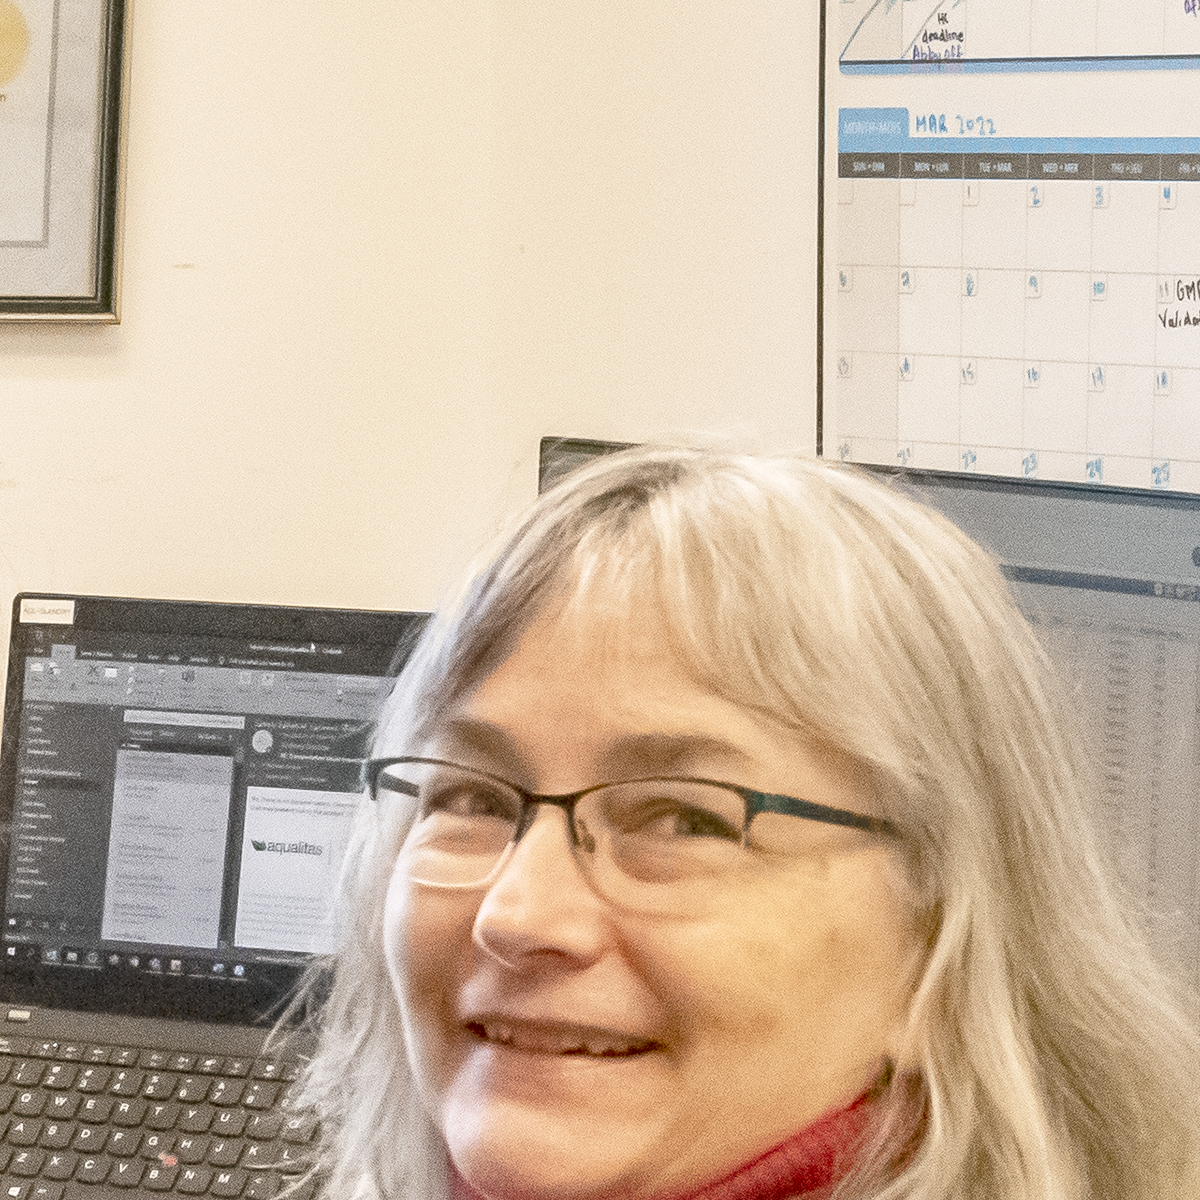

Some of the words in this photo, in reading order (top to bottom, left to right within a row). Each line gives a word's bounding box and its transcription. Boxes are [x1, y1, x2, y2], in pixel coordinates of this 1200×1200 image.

[921, 28, 964, 44] deadline
[915, 113, 949, 134] MAR
[955, 115, 997, 136] 2022
[1158, 308, 1200, 329] Valida
[266, 841, 323, 857] aqualitas
[54, 1096, 68, 1106] W
[86, 1099, 96, 1109] E
[119, 1103, 130, 1113] R
[155, 1106, 164, 1116] T
[188, 1110, 198, 1119] Y
[220, 1113, 231, 1123] U
[13, 1122, 24, 1133] A
[80, 1128, 92, 1138] D
[113, 1132, 125, 1142] F
[148, 1136, 159, 1146] G
[181, 1139, 193, 1149] H
[214, 1143, 225, 1153] J
[248, 1146, 259, 1156] K
[17, 1152, 28, 1163] Z
[50, 1156, 62, 1166] X
[84, 1159, 95, 1169] C
[118, 1163, 129, 1174] V
[149, 1169, 159, 1179] B
[184, 1170, 196, 1180] N
[217, 1173, 231, 1184] M
